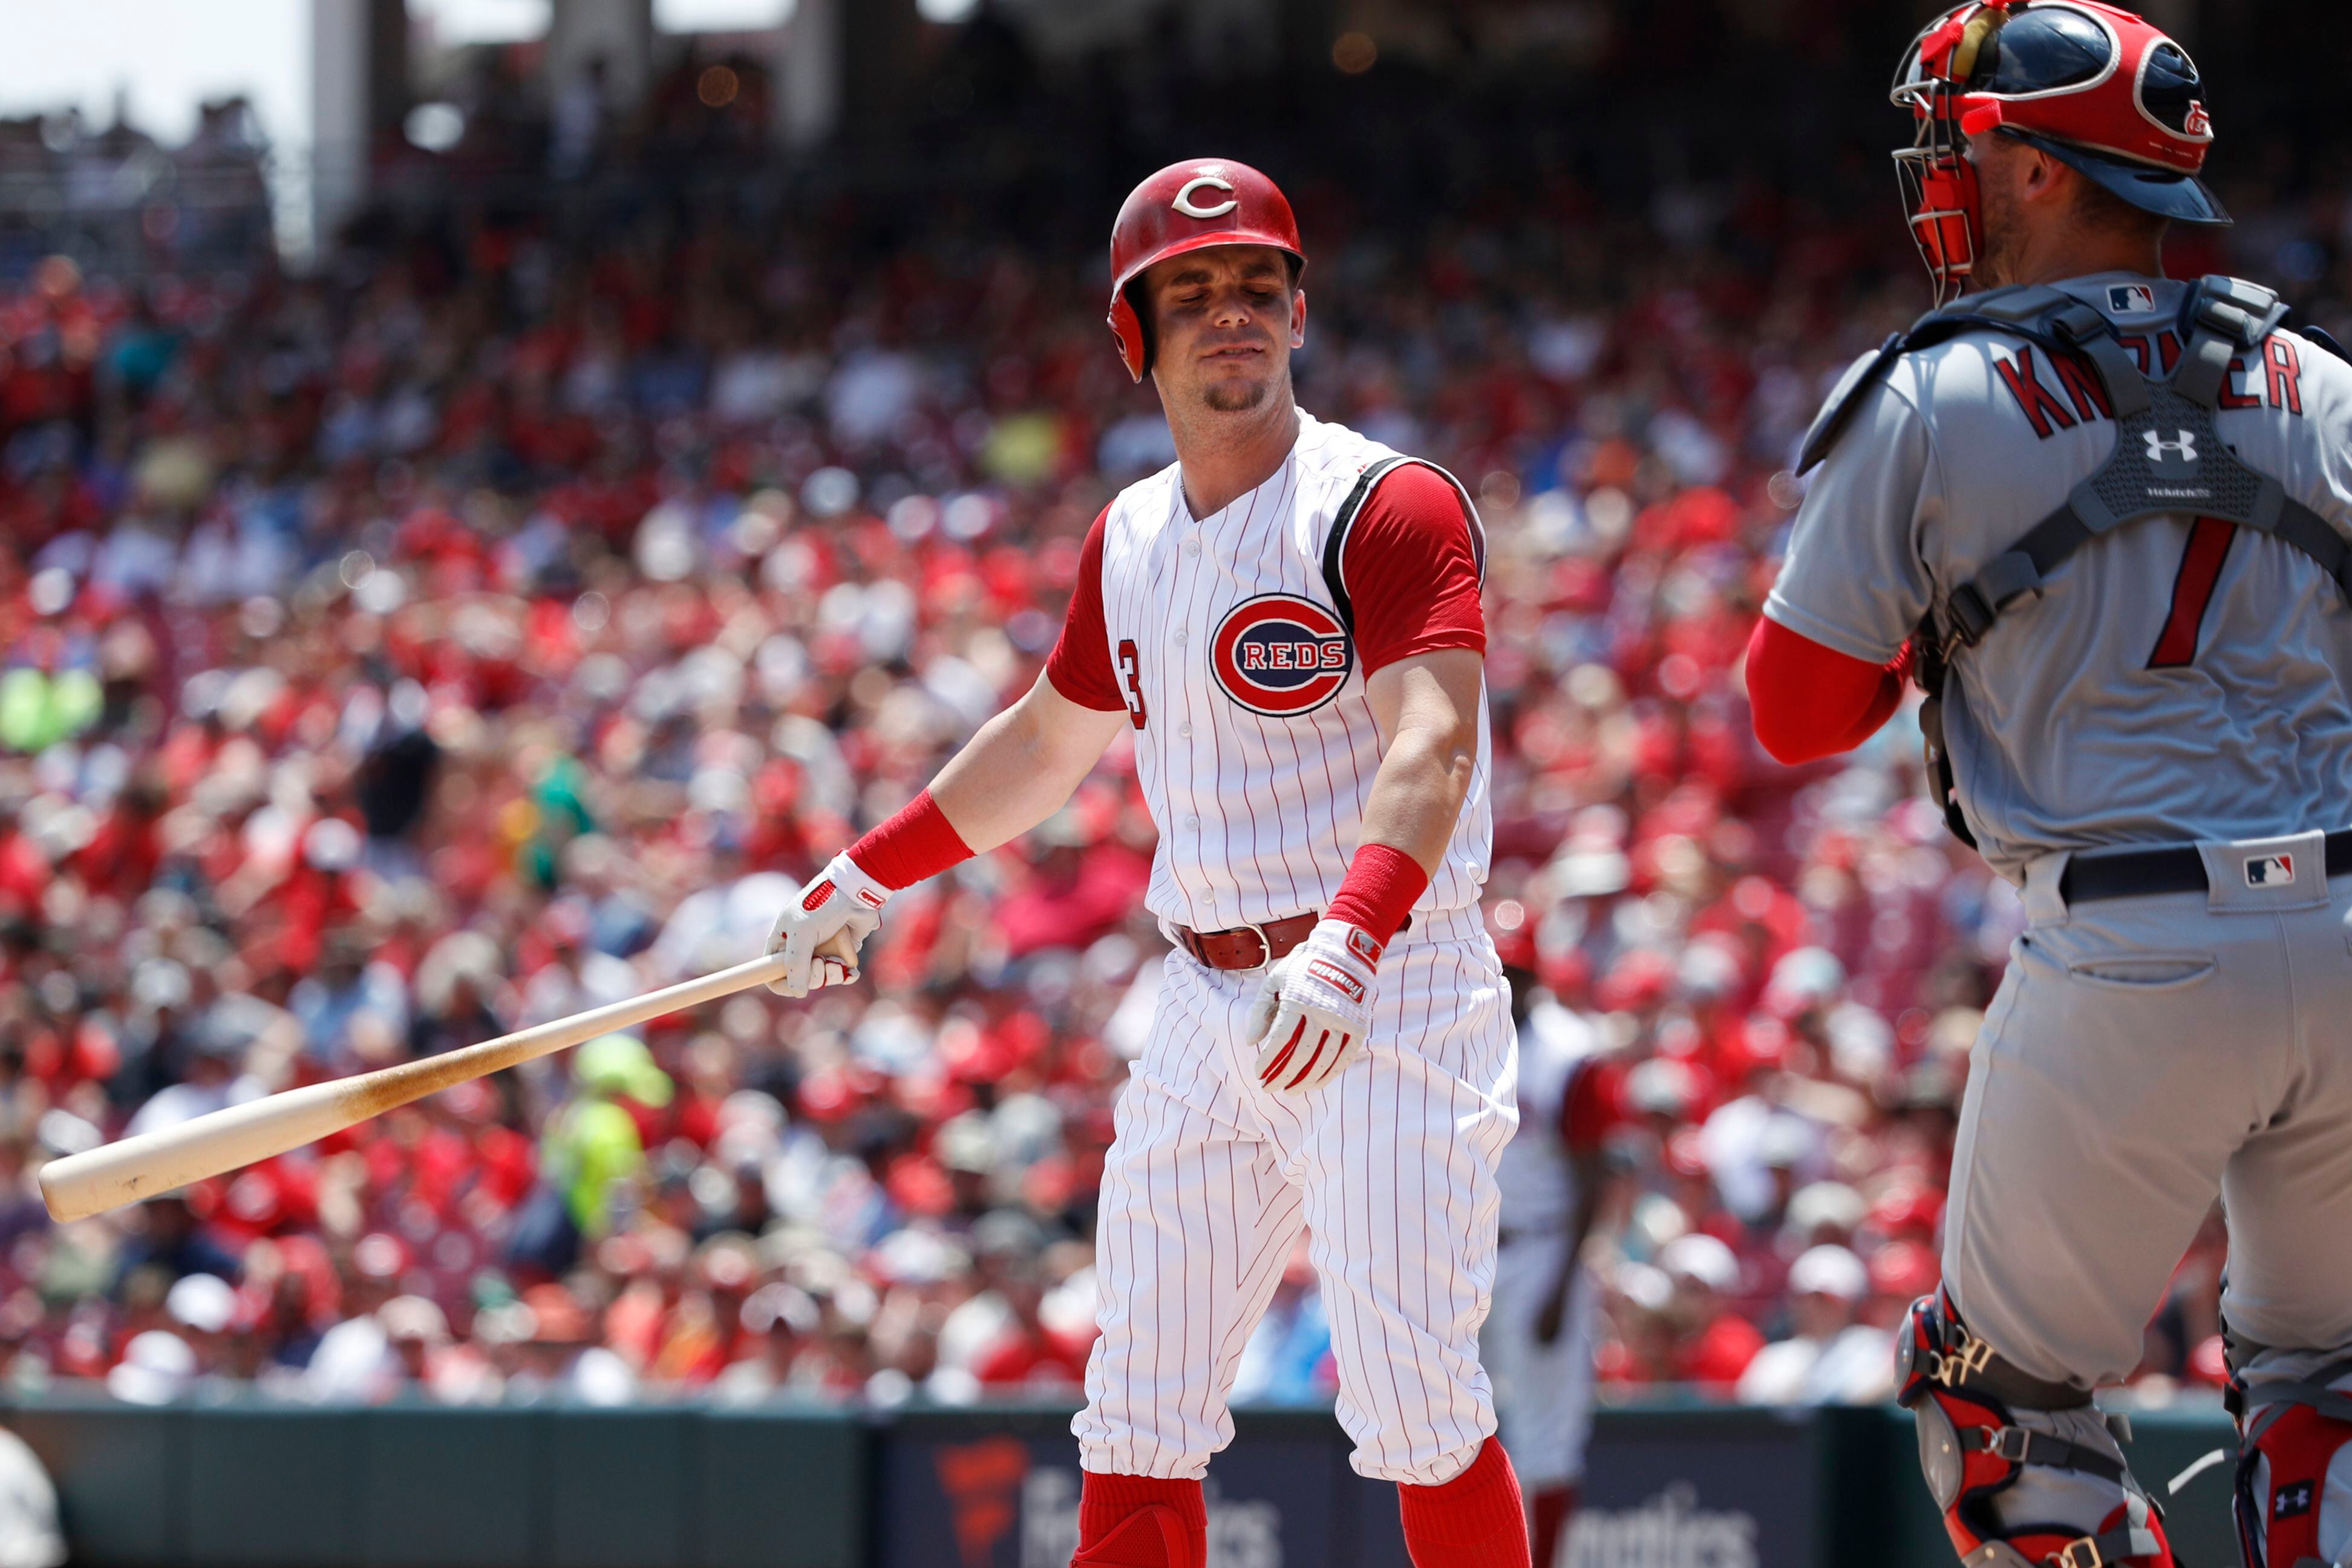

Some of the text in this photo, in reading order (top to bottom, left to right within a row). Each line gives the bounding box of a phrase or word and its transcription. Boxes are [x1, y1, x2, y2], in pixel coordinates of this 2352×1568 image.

[1171, 176, 1238, 218] C
[1243, 639, 1346, 670] REDS
[1118, 639, 1147, 730] 3
